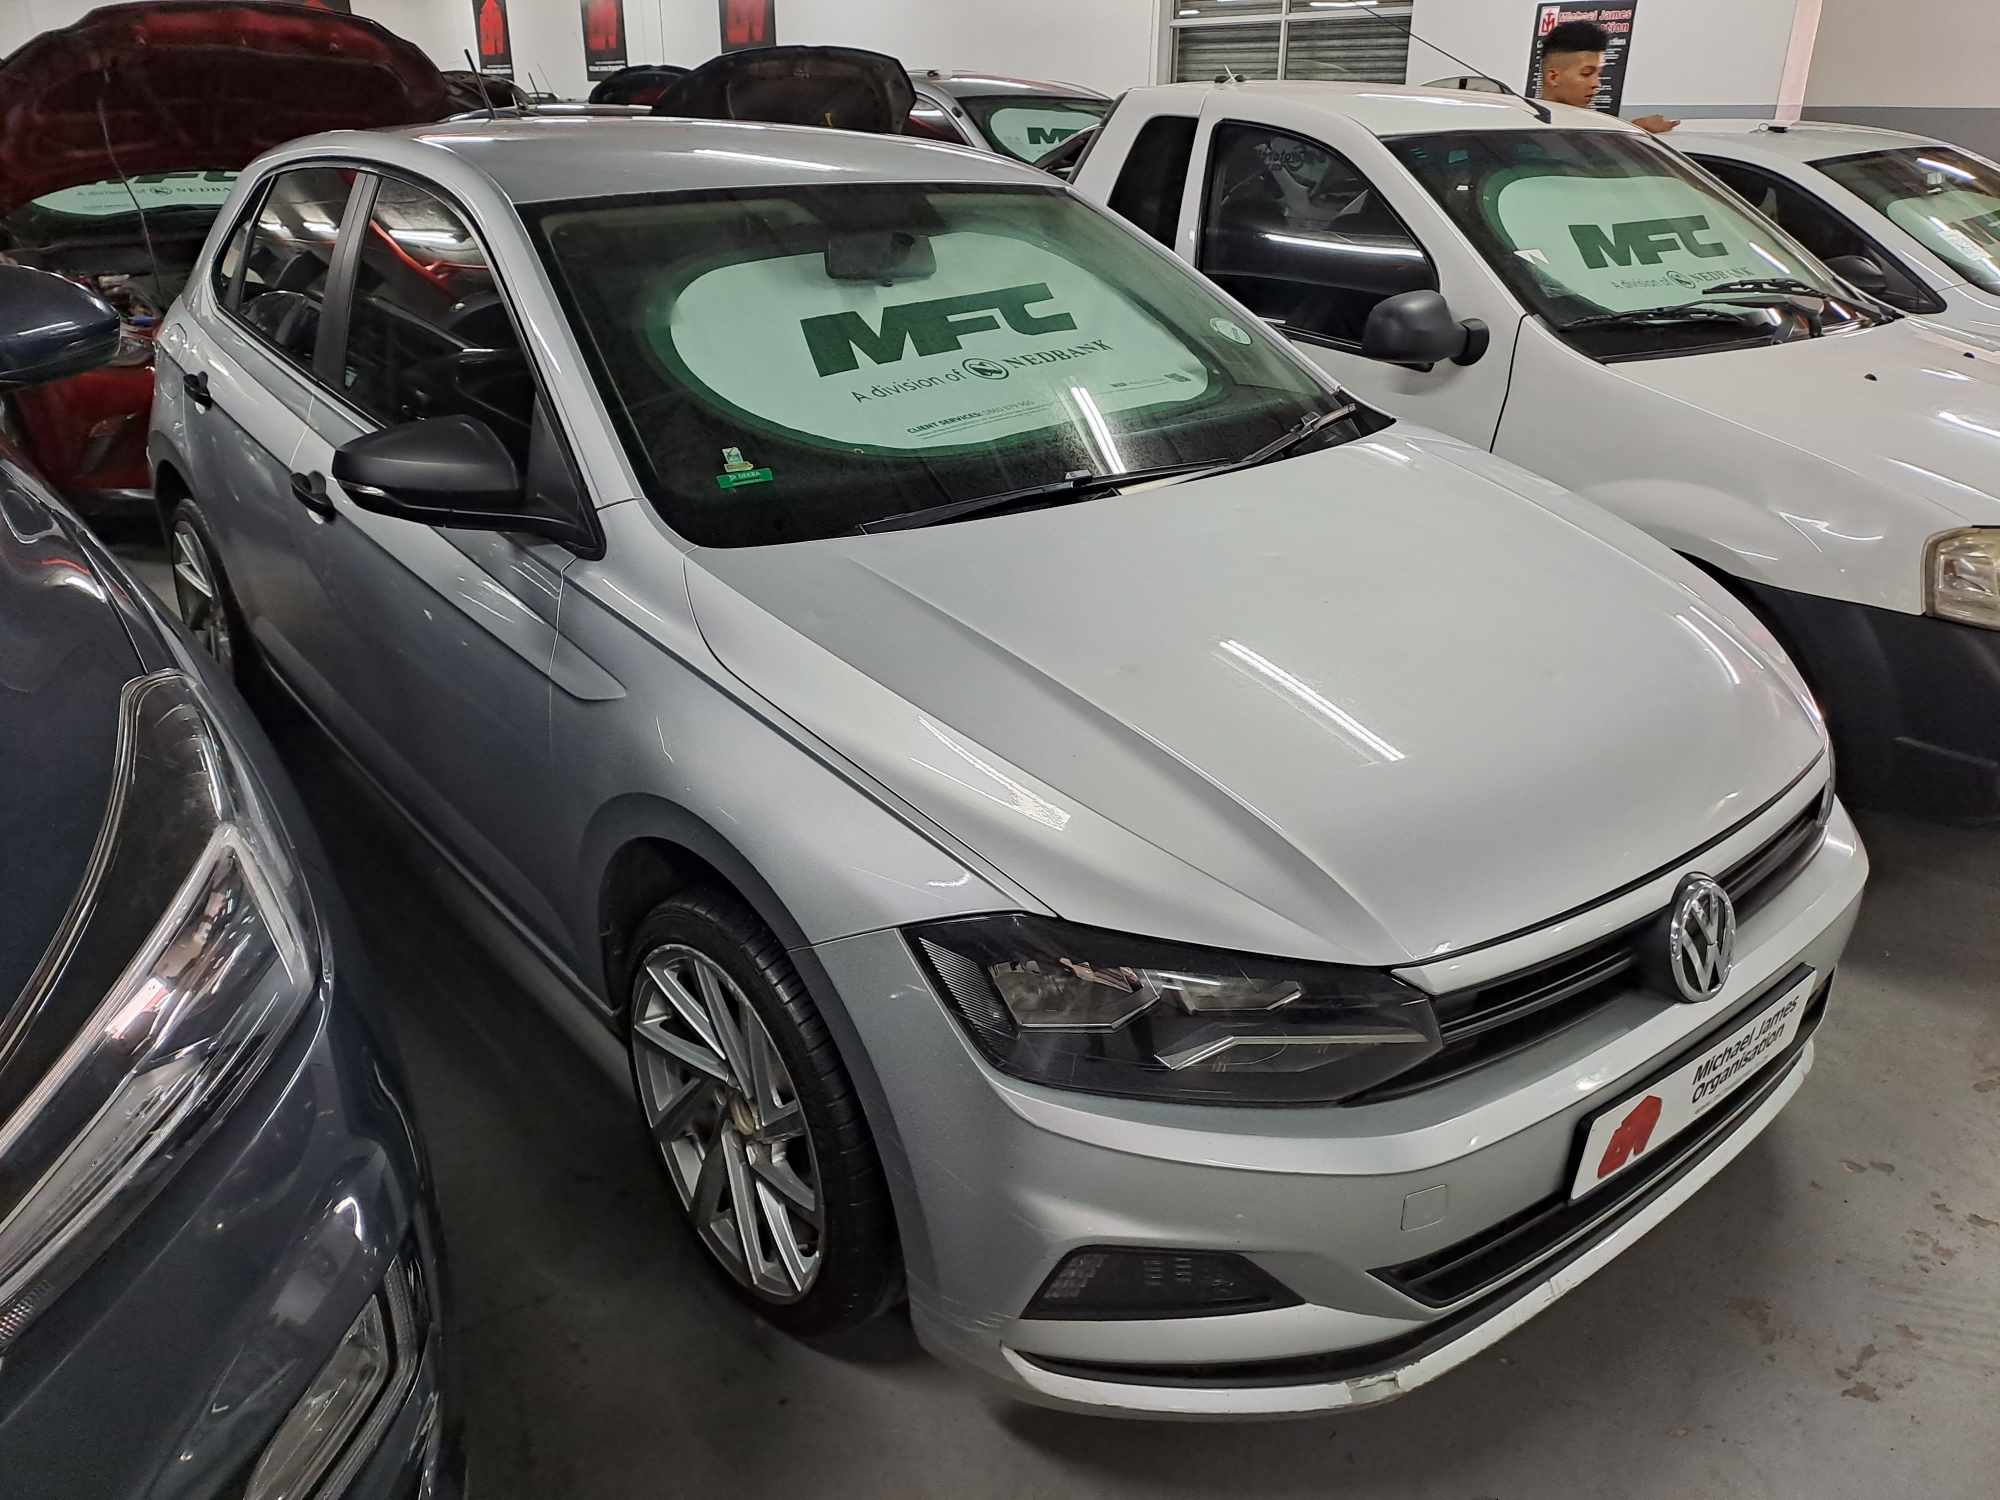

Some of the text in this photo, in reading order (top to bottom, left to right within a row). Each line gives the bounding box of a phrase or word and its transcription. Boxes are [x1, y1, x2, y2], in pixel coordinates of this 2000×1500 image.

[1599, 10, 1632, 20] James
[1568, 215, 1729, 269] MFC
[800, 282, 1077, 377] MFC
[851, 339, 1113, 403] A division of NEDBANK
[1692, 1027, 1756, 1085] Michael
[1755, 995, 1799, 1040] James
[1692, 1023, 1785, 1103] Organisation
